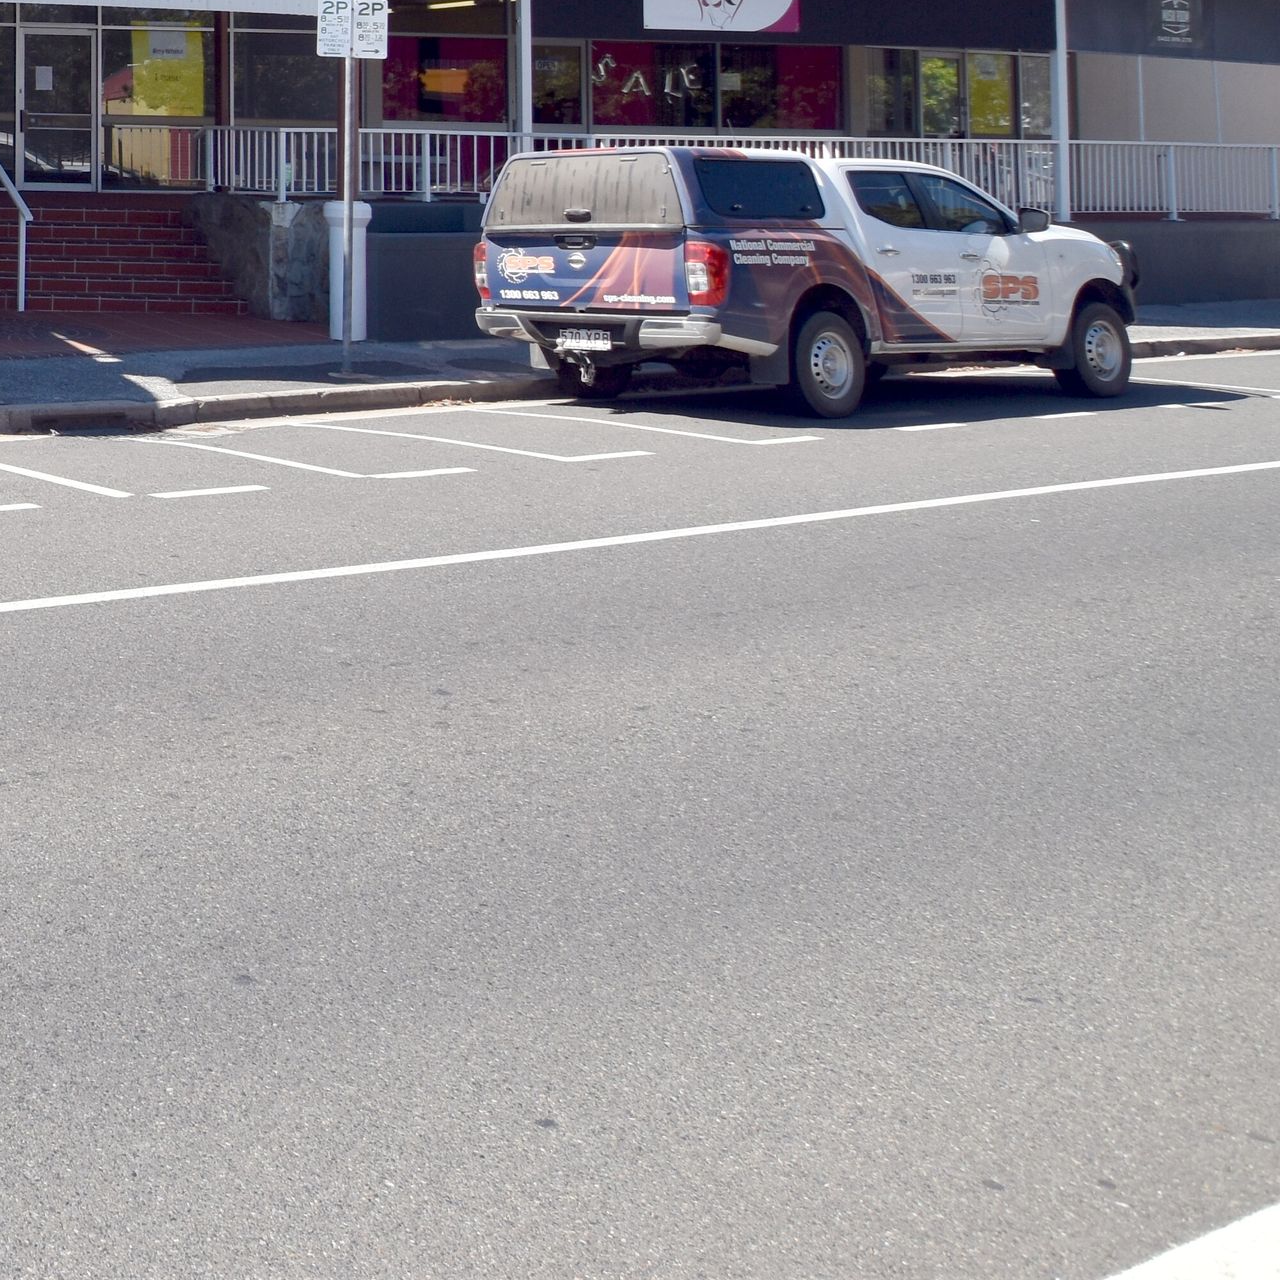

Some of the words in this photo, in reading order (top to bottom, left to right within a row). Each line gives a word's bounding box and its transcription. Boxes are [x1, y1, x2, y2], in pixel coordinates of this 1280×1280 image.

[323, 1, 348, 14] 2P
[358, 2, 384, 16] 2P
[592, 54, 702, 97] SALE
[729, 239, 766, 250] National
[766, 239, 816, 251] Commercial
[505, 256, 555, 270] SPS
[733, 253, 771, 266] Cleaning
[772, 253, 809, 266] Company
[912, 274, 928, 283] 1300
[982, 275, 1039, 299] SPS
